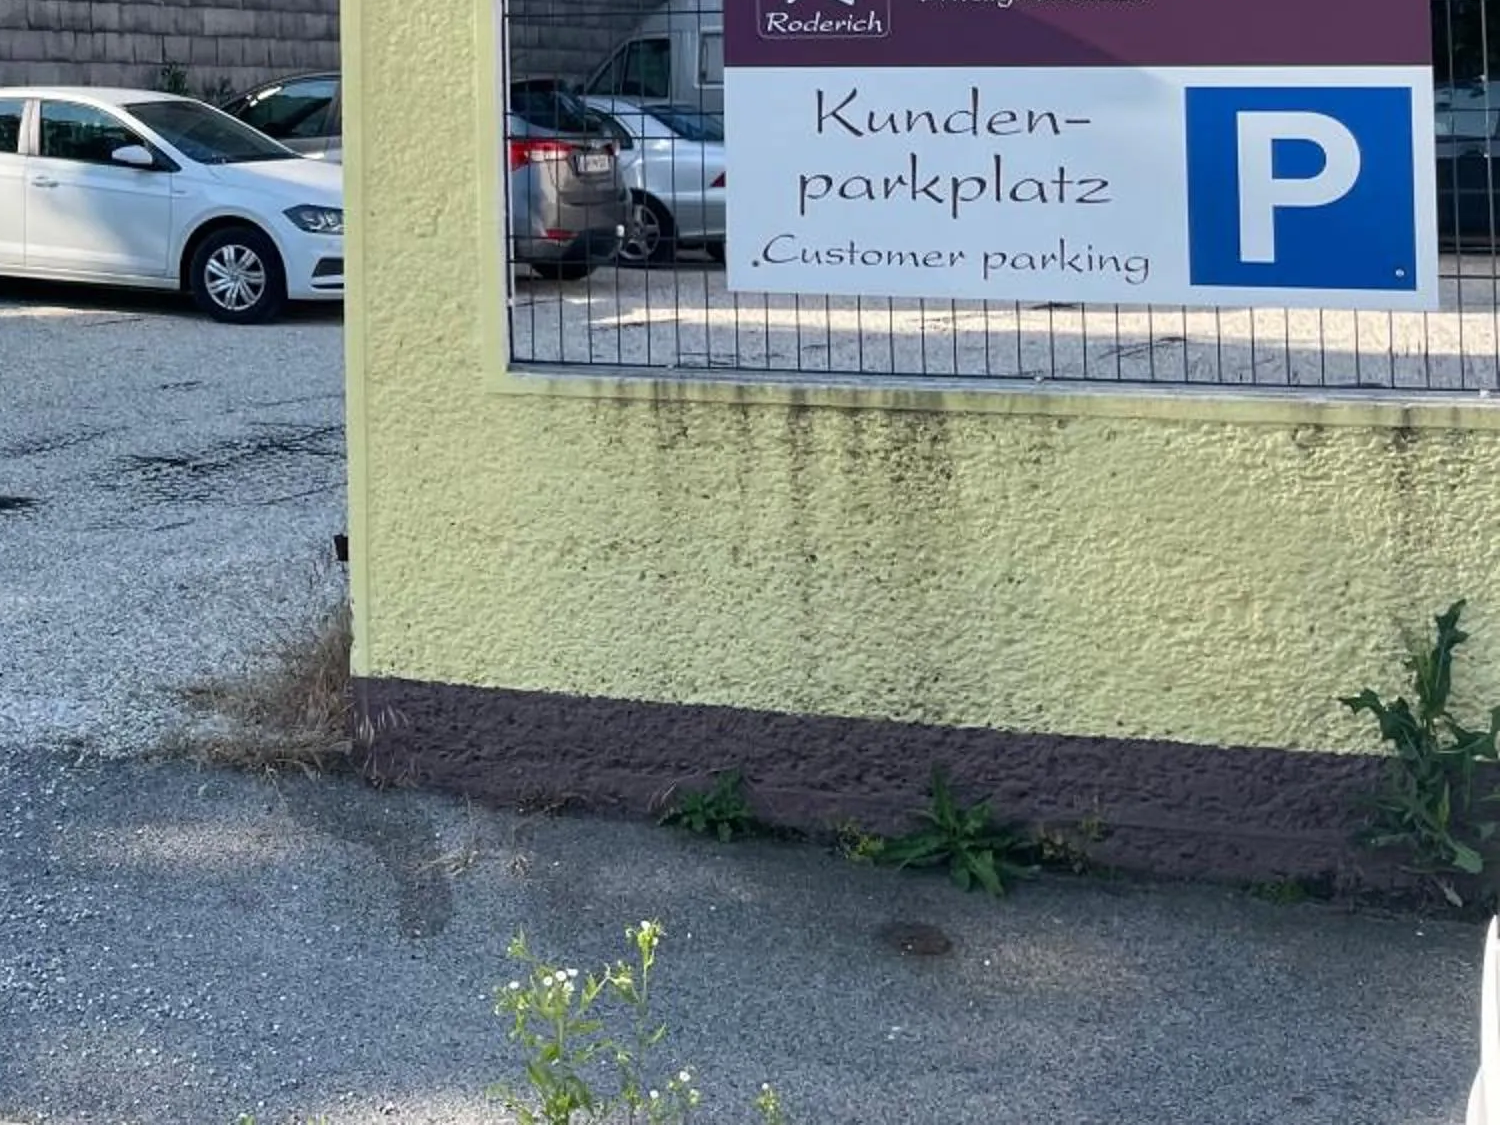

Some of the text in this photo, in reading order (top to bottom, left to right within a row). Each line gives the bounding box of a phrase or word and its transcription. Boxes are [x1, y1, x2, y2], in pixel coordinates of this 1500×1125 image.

[766, 10, 884, 33] Roderich
[815, 86, 1092, 137] Kunden-
[799, 152, 1114, 219] parkplatz
[1236, 110, 1362, 264] P
[761, 233, 1151, 285] Customer parking
